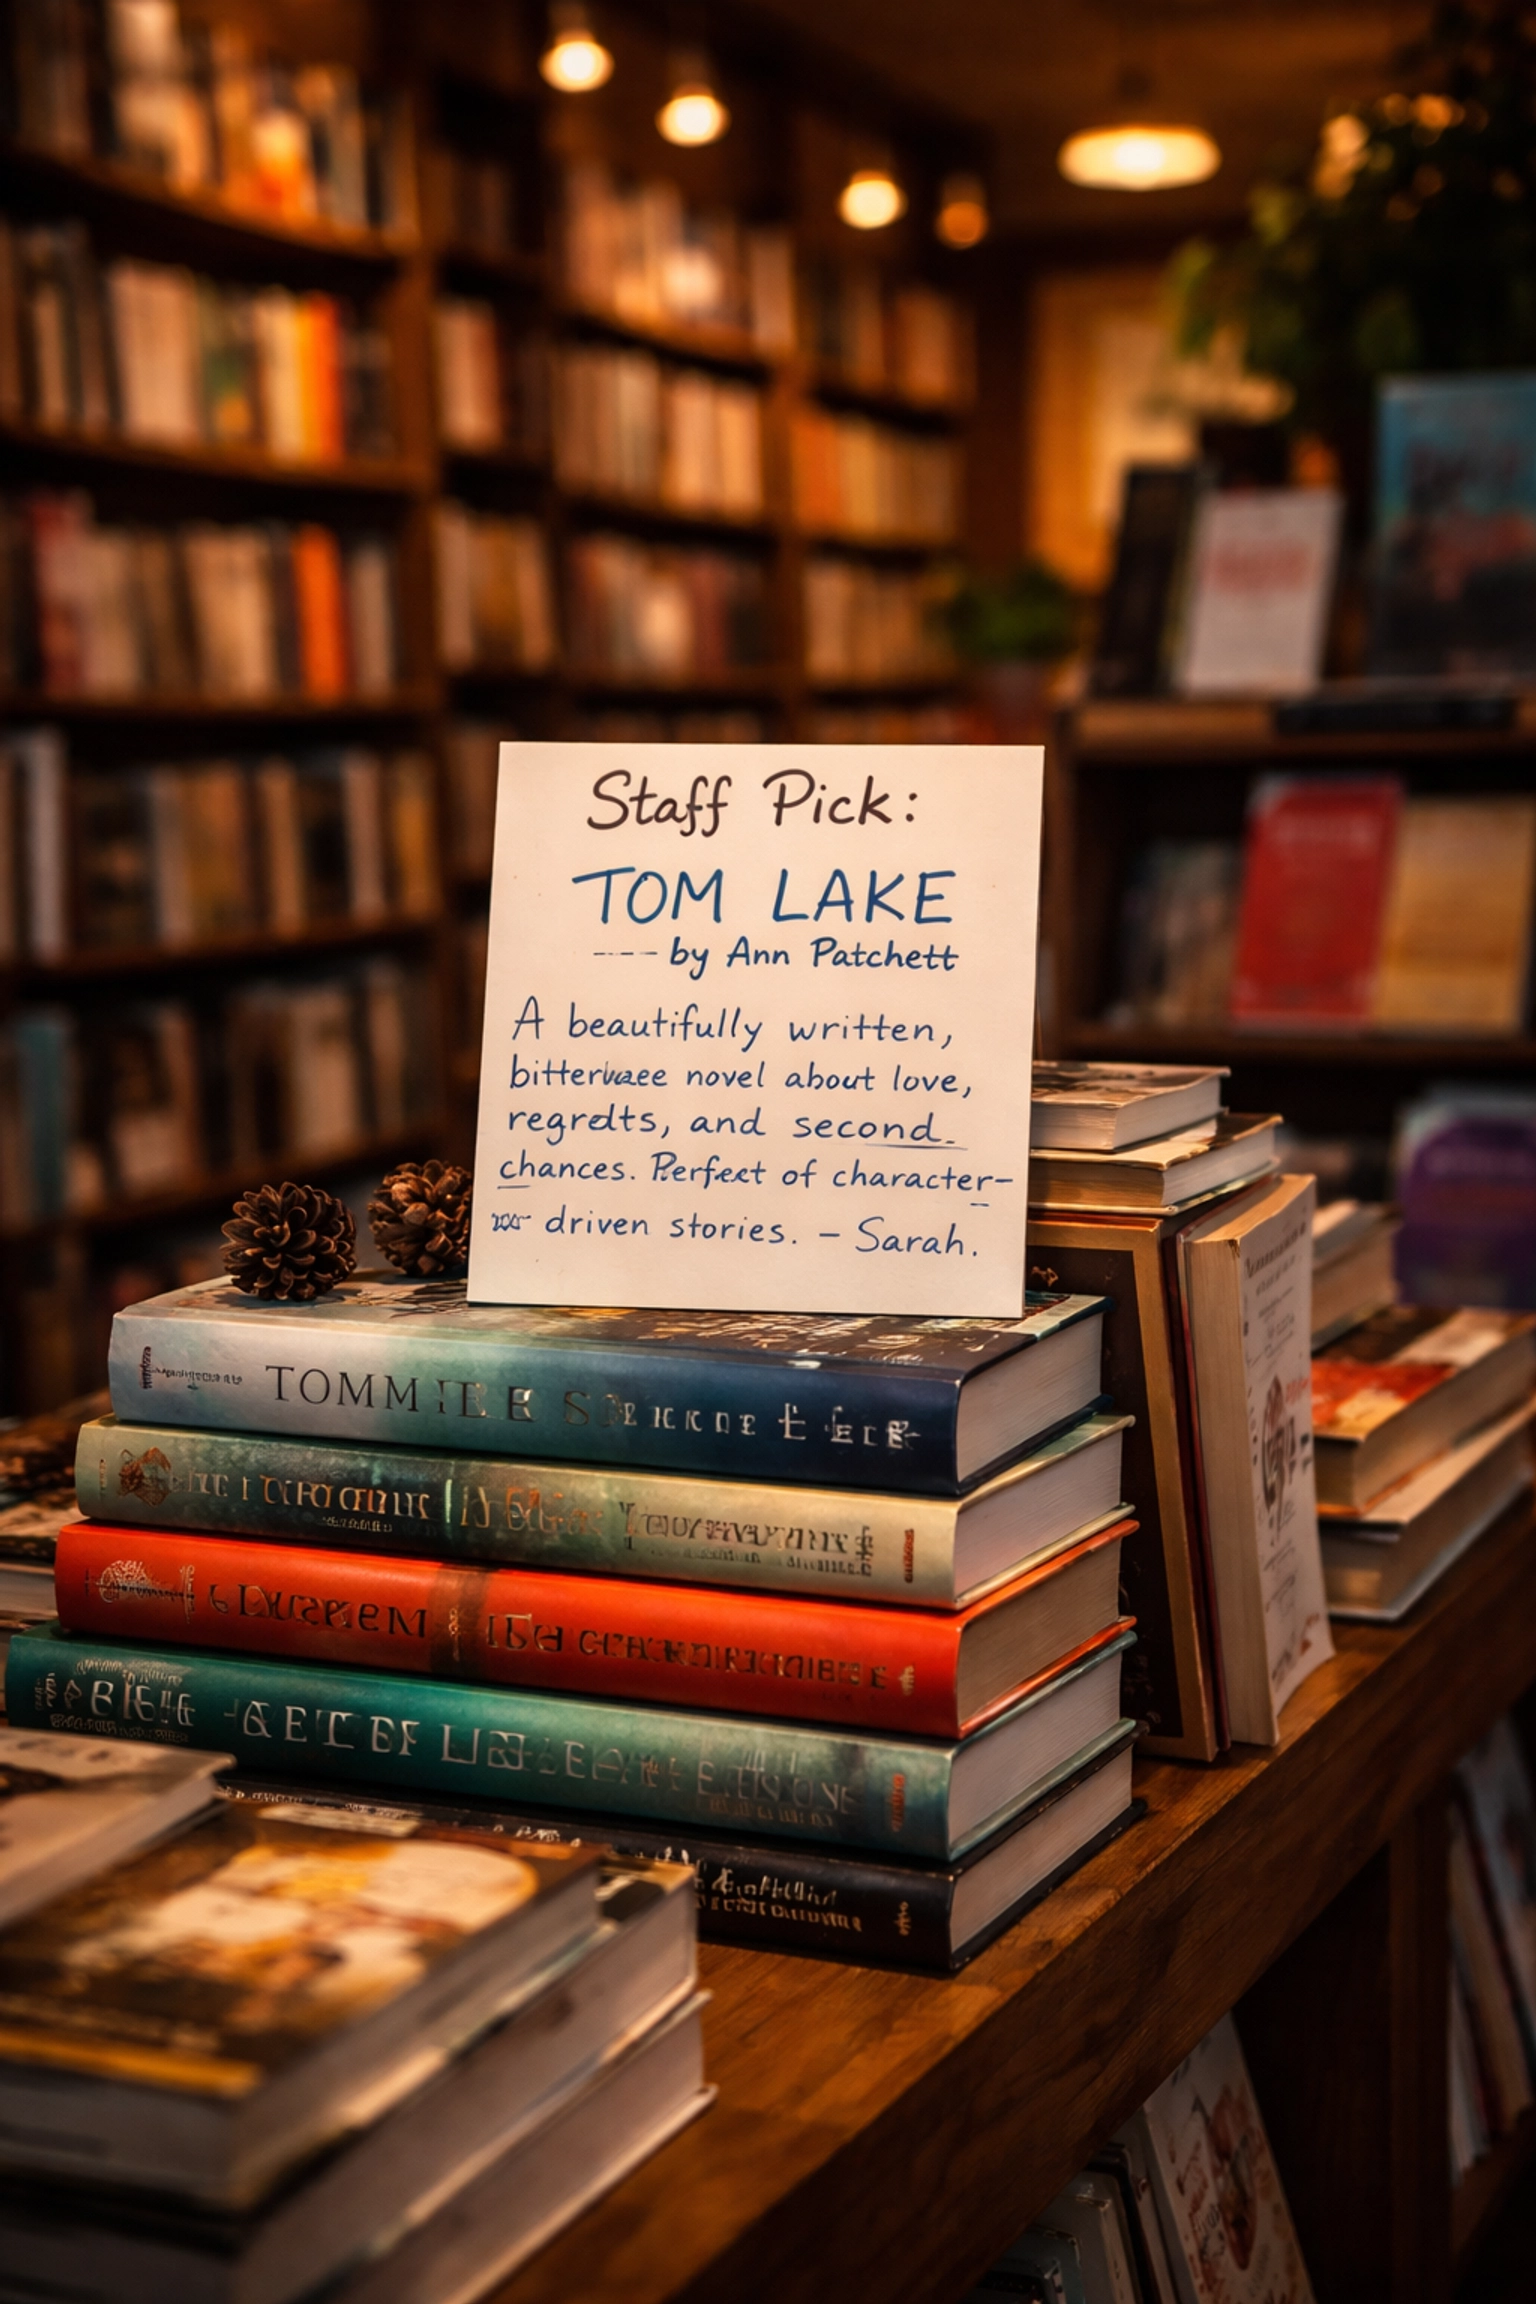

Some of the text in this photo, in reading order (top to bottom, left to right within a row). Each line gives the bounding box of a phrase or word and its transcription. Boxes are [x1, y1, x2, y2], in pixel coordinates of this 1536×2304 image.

[586, 768, 919, 838] Staff Pick:
[571, 865, 957, 925] TOM LAKE
[669, 935, 960, 982] by Ann Patchett
[511, 994, 954, 1054] A beautifully written,
[686, 1060, 766, 1089] novel
[784, 1066, 876, 1092] about
[892, 1063, 973, 1100] love,
[689, 1106, 767, 1138] and
[499, 1148, 637, 1182] chances.
[781, 1157, 818, 1190] of
[832, 1158, 1014, 1194] character-
[545, 1203, 650, 1236] driven
[669, 1211, 798, 1246] stories.
[854, 1215, 979, 1258] Sarah.
